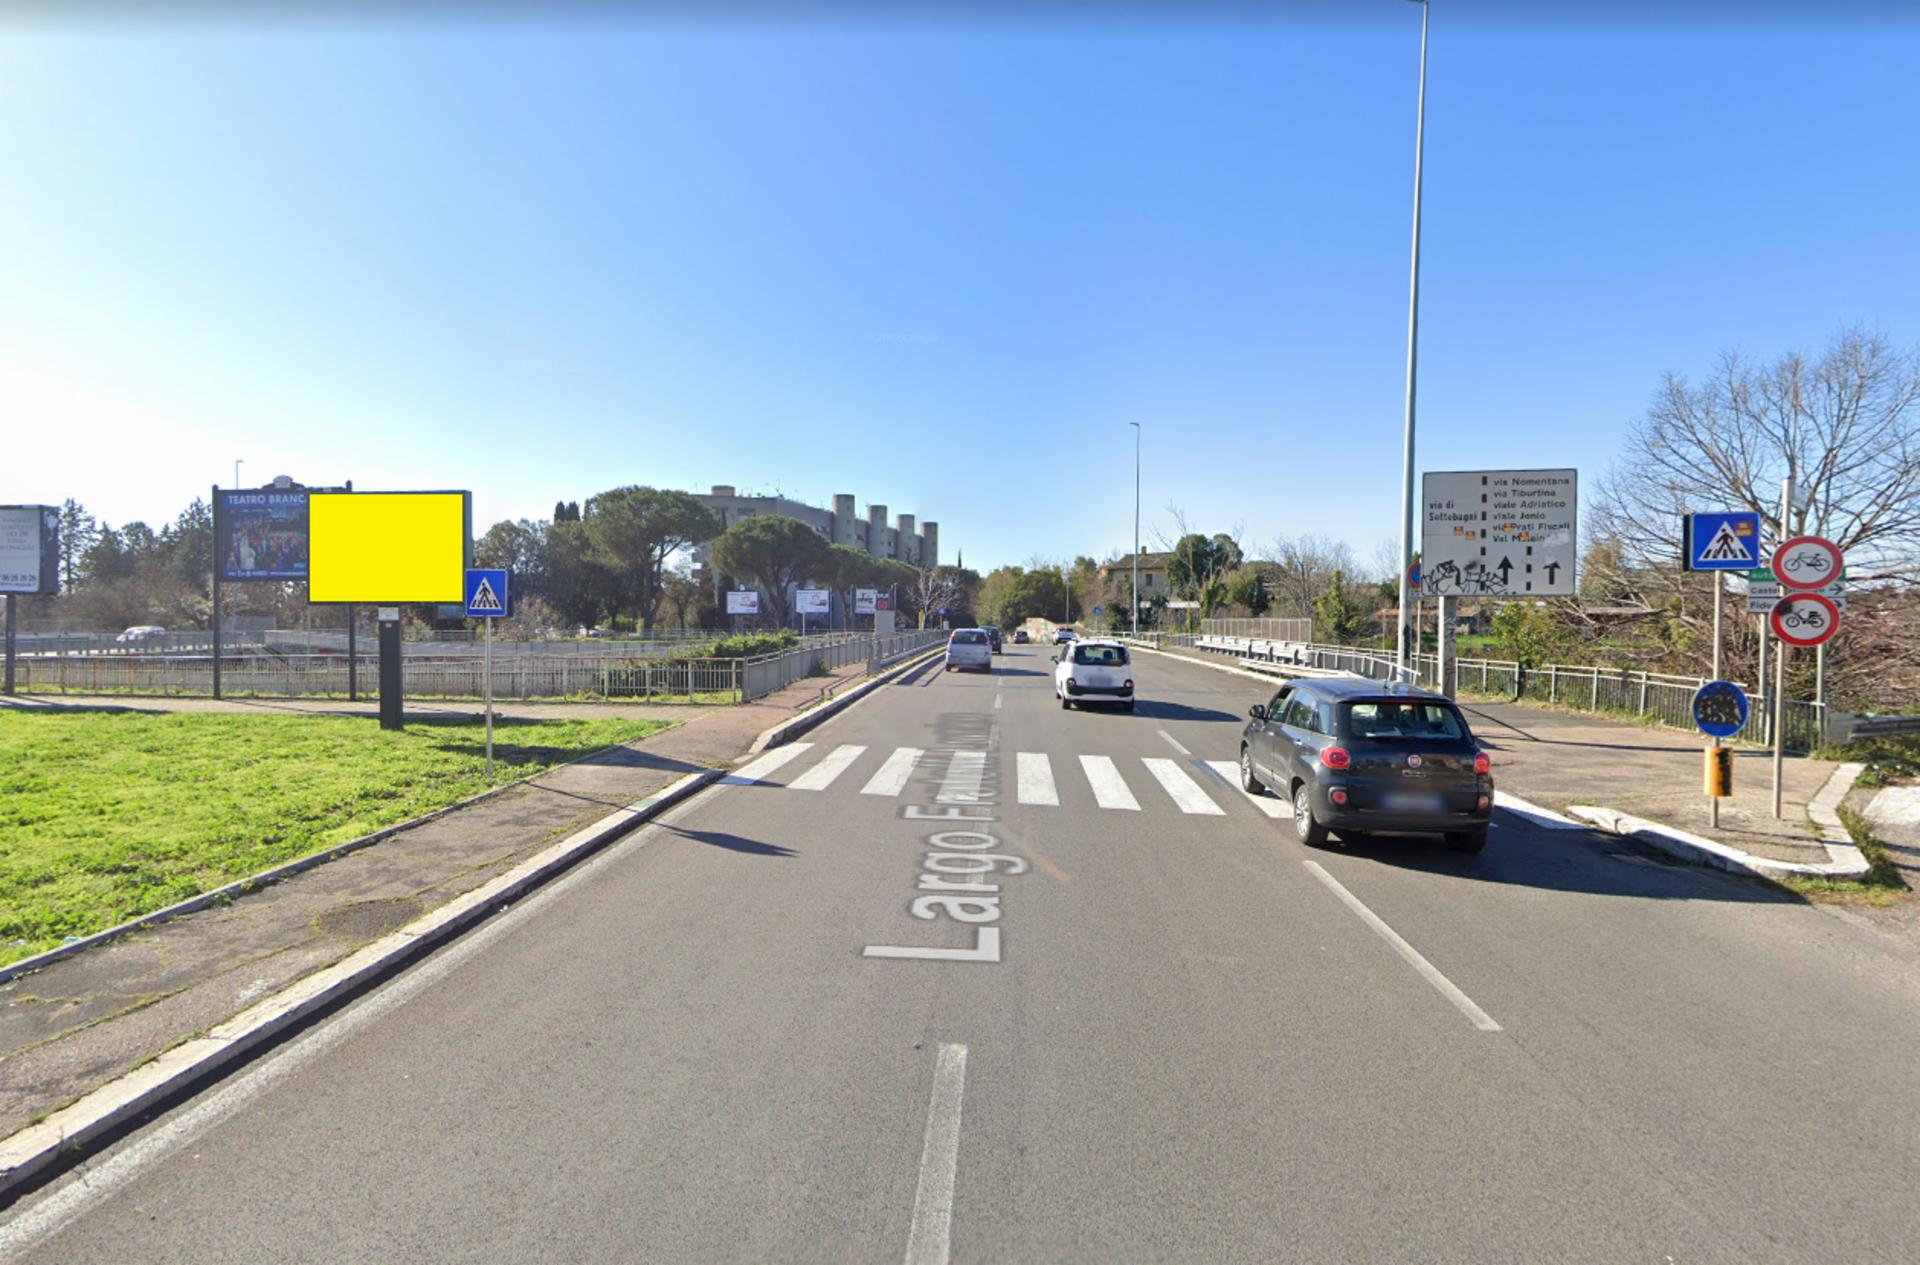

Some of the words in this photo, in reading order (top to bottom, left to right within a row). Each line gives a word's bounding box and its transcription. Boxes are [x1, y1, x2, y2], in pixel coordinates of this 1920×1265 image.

[1493, 478, 1508, 486] via
[1511, 477, 1570, 486] Nomentana
[1493, 489, 1508, 498] via
[1511, 488, 1557, 497] Tiburtina
[228, 495, 266, 505] TEATRO
[268, 494, 305, 504] BRANC
[1493, 501, 1517, 509] viale
[1520, 500, 1567, 509] Adriatico
